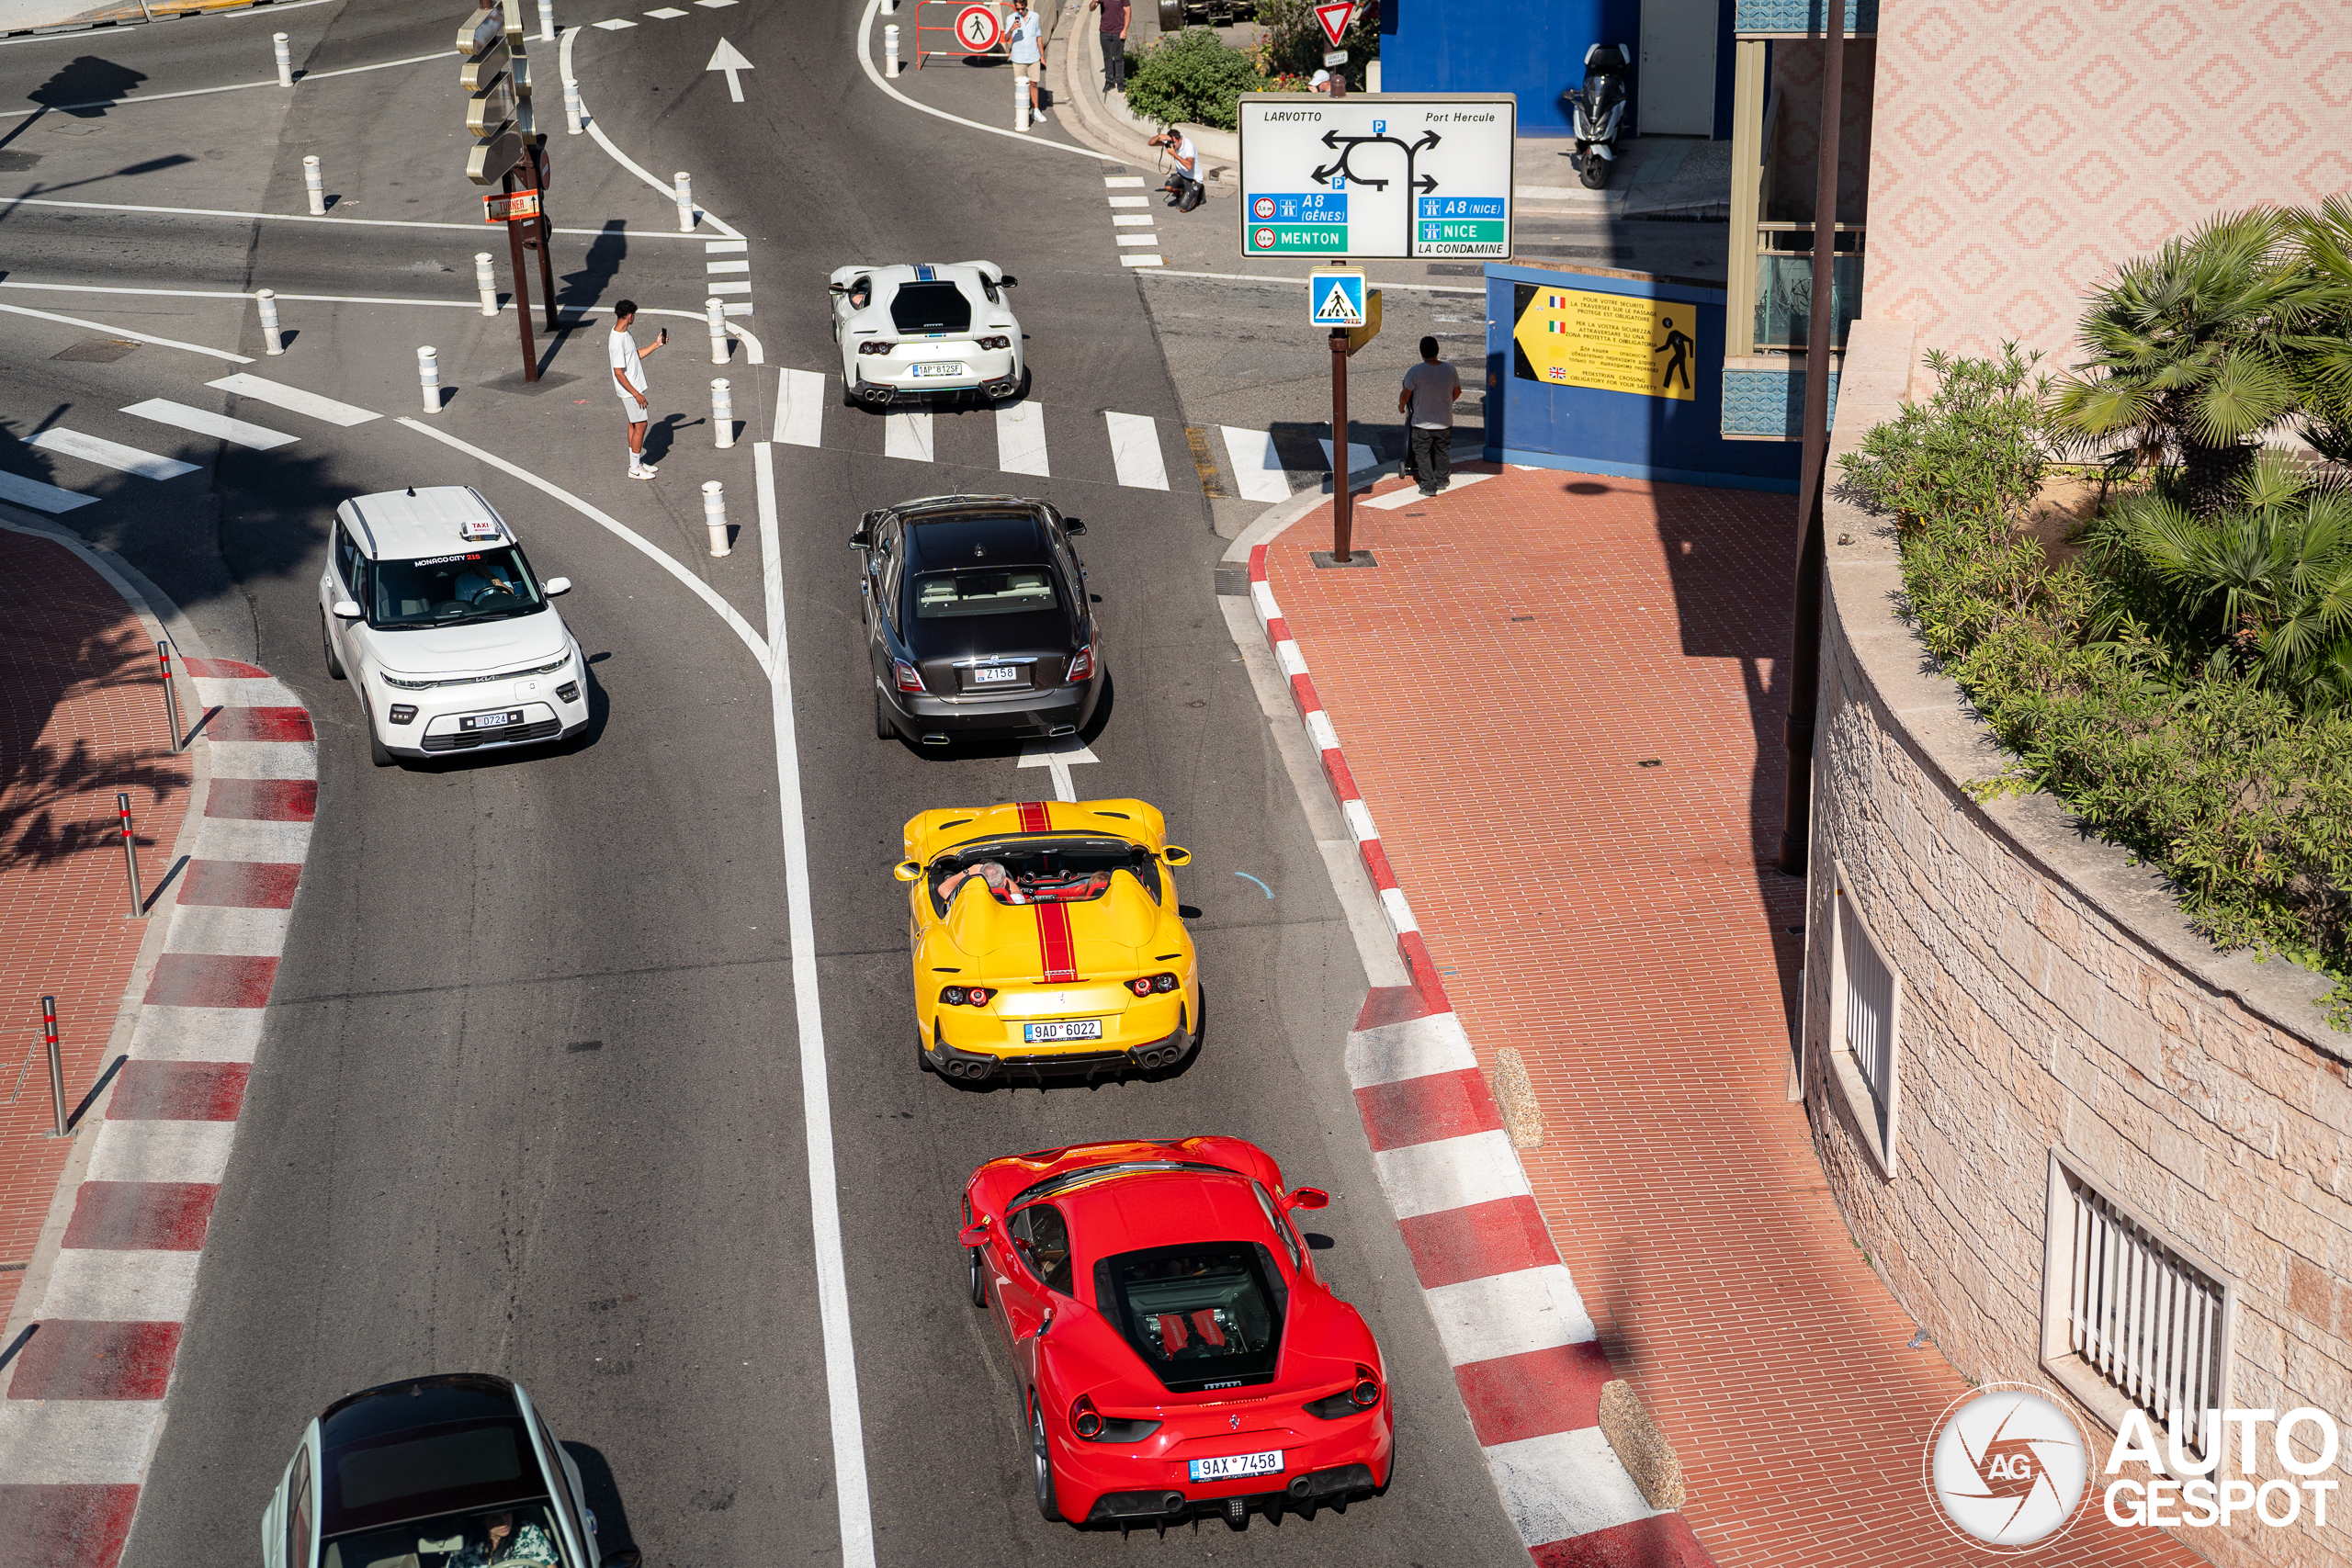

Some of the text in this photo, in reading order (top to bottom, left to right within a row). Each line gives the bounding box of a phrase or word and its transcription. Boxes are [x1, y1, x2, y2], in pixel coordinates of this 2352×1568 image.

[1264, 112, 1322, 121] LARVOTTO
[1426, 112, 1495, 122] Port Hercule
[1374, 121, 1384, 132] P
[1334, 178, 1343, 189] P
[499, 198, 525, 211] TURNER
[1302, 195, 1325, 208] A8
[1444, 200, 1501, 215] A8 (NICE)
[1302, 209, 1345, 221] (GÊNES)
[1444, 225, 1477, 238] NICE
[1281, 232, 1339, 244] MENTON
[1419, 243, 1504, 254] LA CONDAMINE
[1614, 313, 1650, 322] OBLIGATOIRE
[1633, 309, 1657, 317] PASSAGE
[1579, 327, 1621, 337] ATTRAVERSARE
[1622, 326, 1652, 335] SICUREZZA
[1583, 333, 1611, 342] PROTETTA
[919, 366, 933, 374] 1AP
[1570, 375, 1604, 384] OBLIGATORY
[1619, 375, 1645, 383] CROSSING
[414, 556, 449, 568] MONACO
[484, 715, 506, 726] 0724
[1035, 1022, 1095, 1038] 9AD 6022
[1203, 1453, 1276, 1475] 9AX 7458
